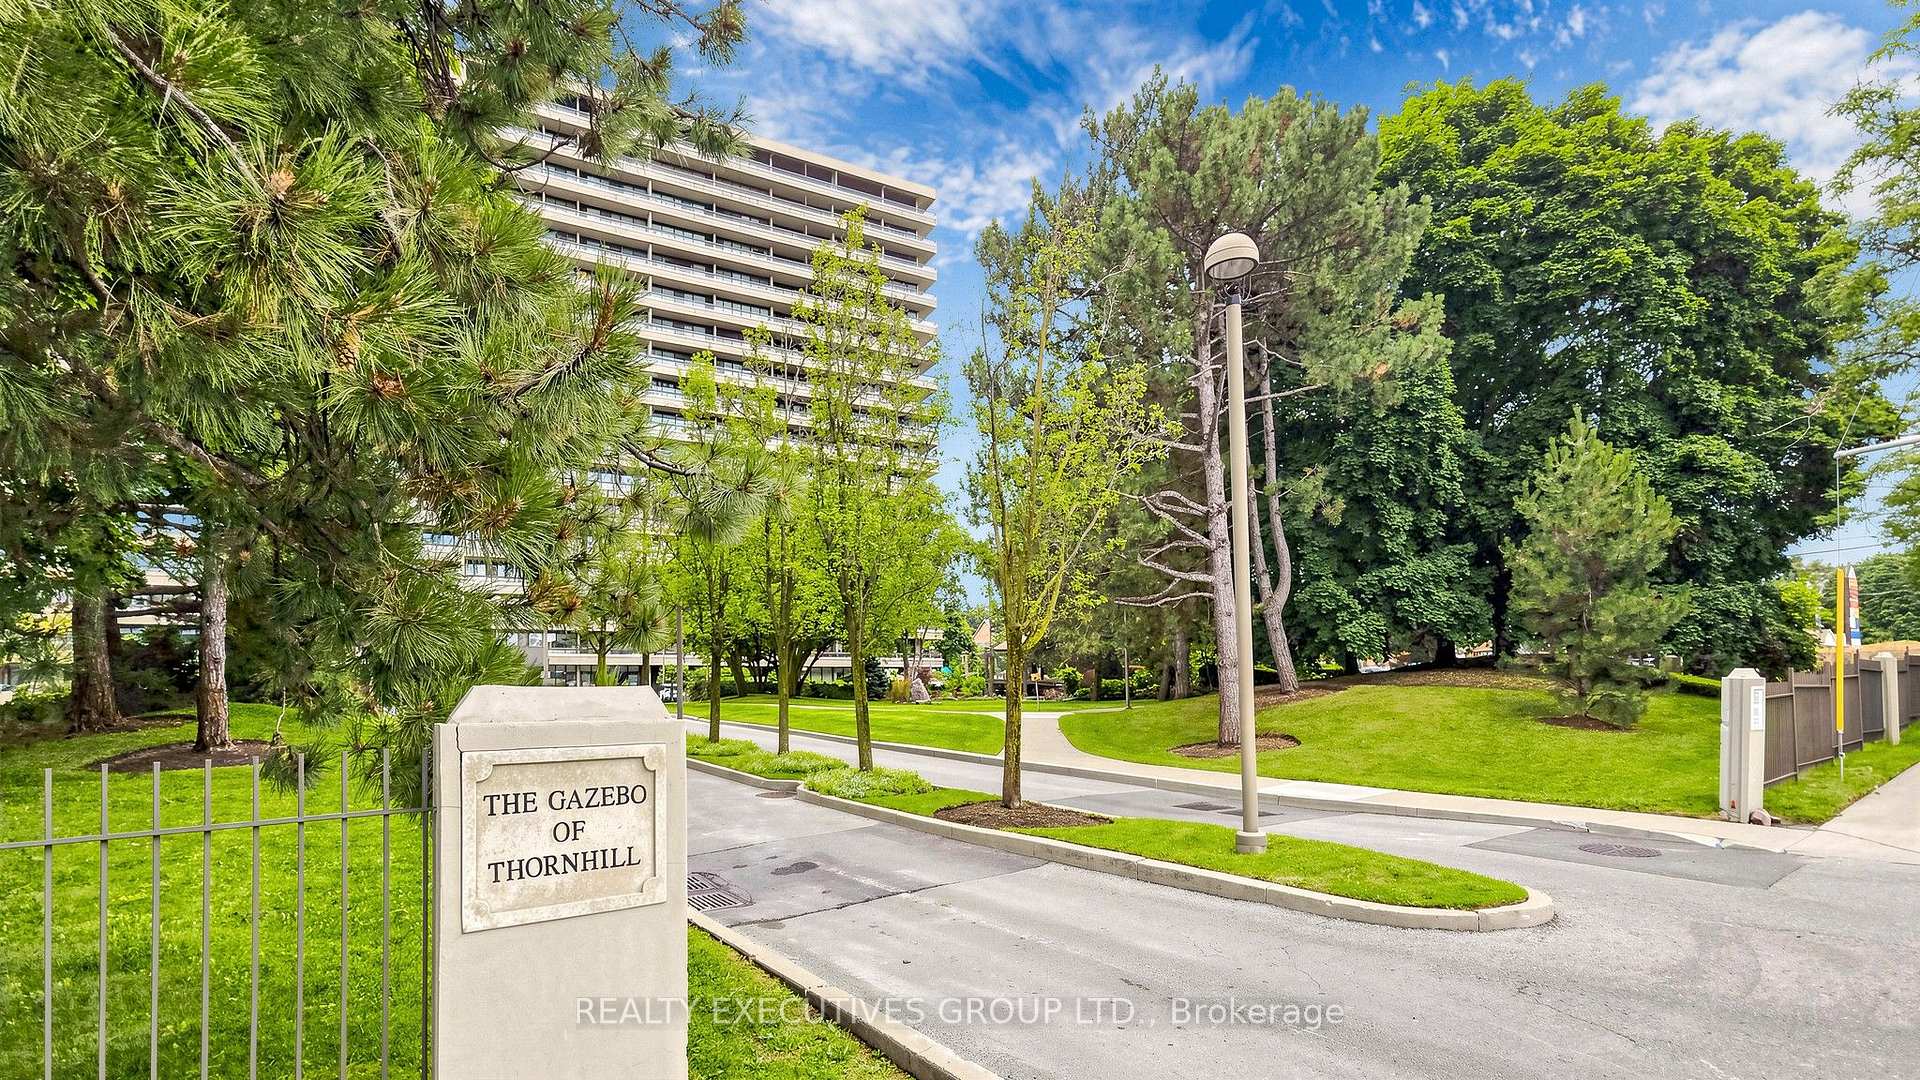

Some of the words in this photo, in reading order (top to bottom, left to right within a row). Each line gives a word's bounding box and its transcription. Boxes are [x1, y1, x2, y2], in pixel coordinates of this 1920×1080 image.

[483, 792, 538, 816] THE
[548, 784, 647, 811] GAZEBO
[552, 821, 586, 842] OF
[487, 847, 641, 883] THORNHILL
